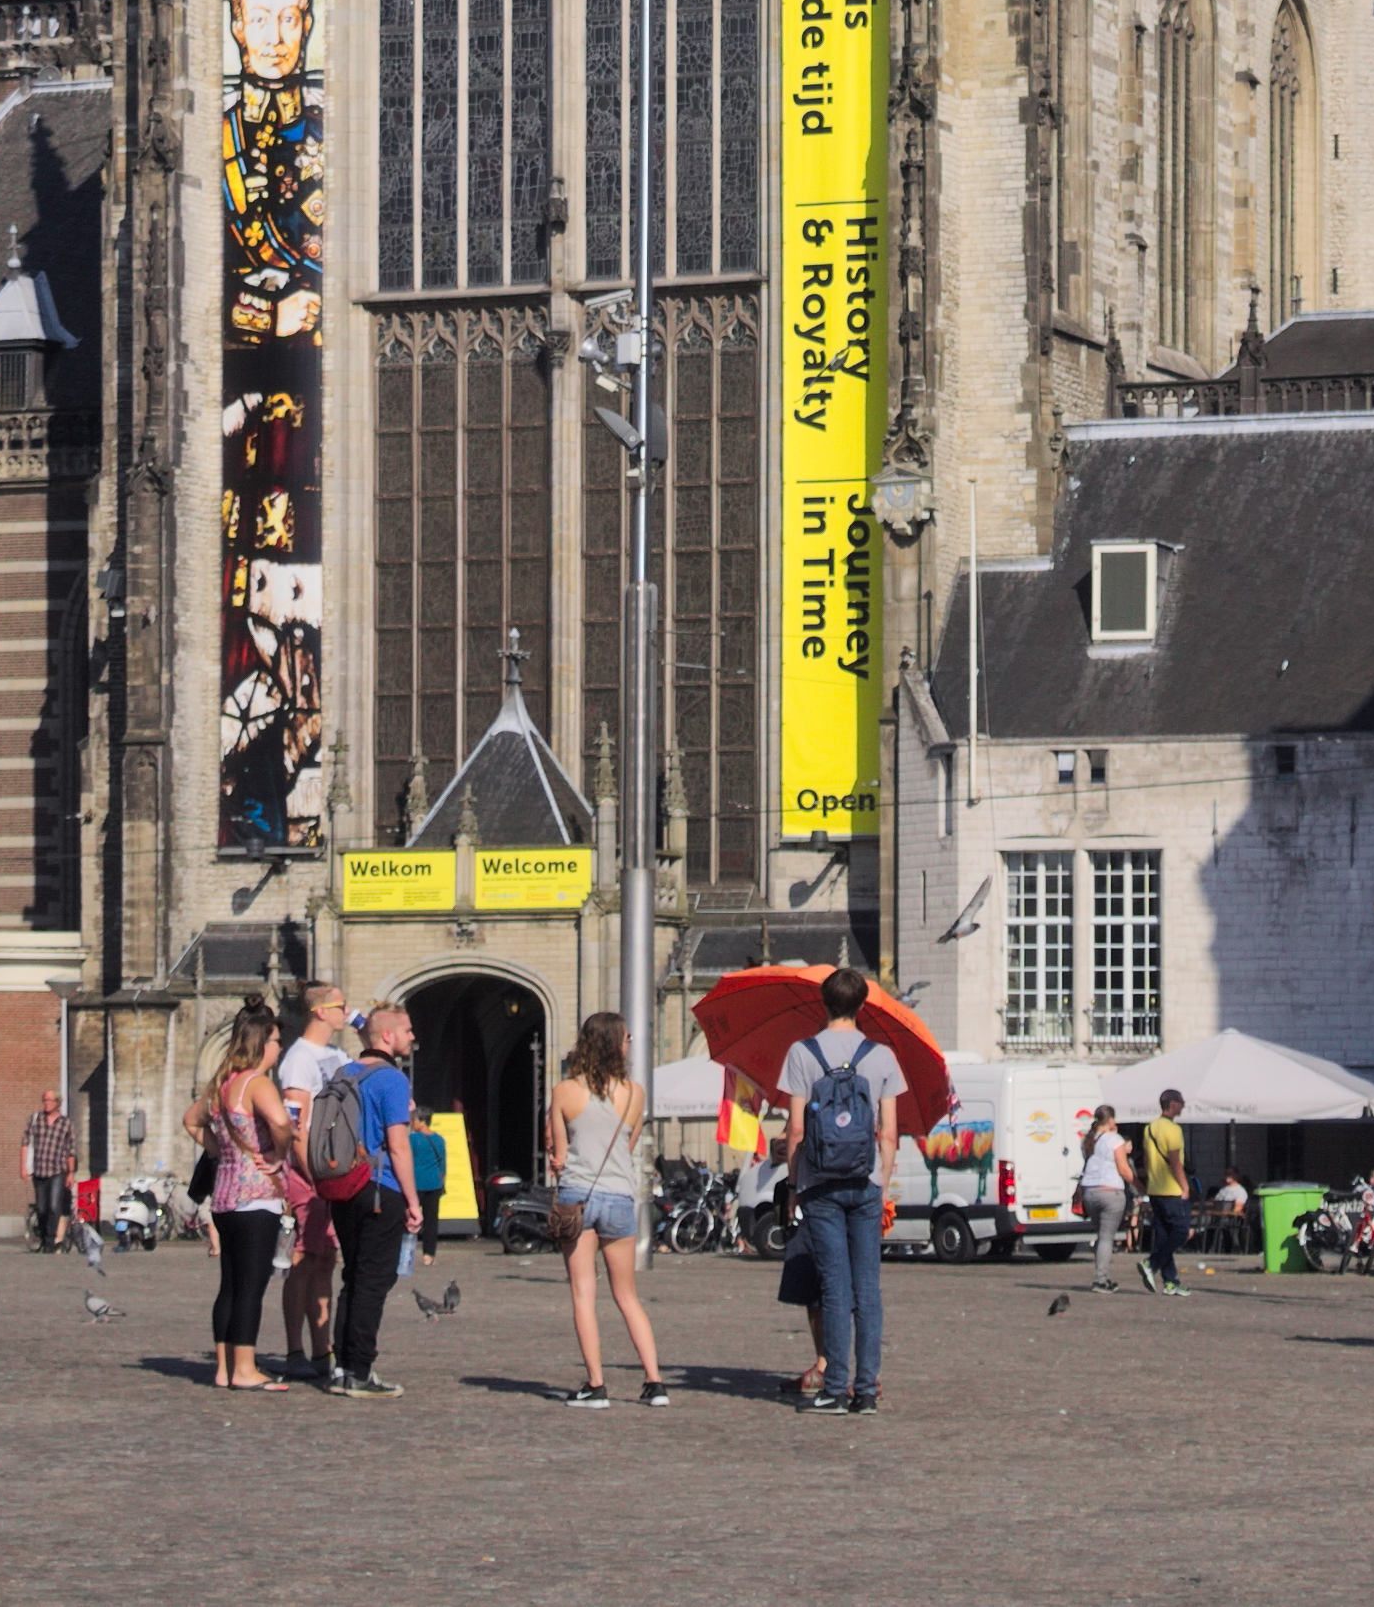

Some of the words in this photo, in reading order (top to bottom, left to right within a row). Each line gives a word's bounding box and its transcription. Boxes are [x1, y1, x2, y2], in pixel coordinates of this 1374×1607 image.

[792, 61, 834, 136] tijd
[801, 218, 834, 247] &
[837, 216, 879, 383] History
[793, 263, 836, 433] Royalty
[801, 496, 836, 535] in
[801, 548, 836, 659] Time
[837, 493, 873, 680] Journey
[797, 788, 877, 818] Open
[349, 860, 432, 877] Welkom
[482, 858, 578, 874] Welcome
